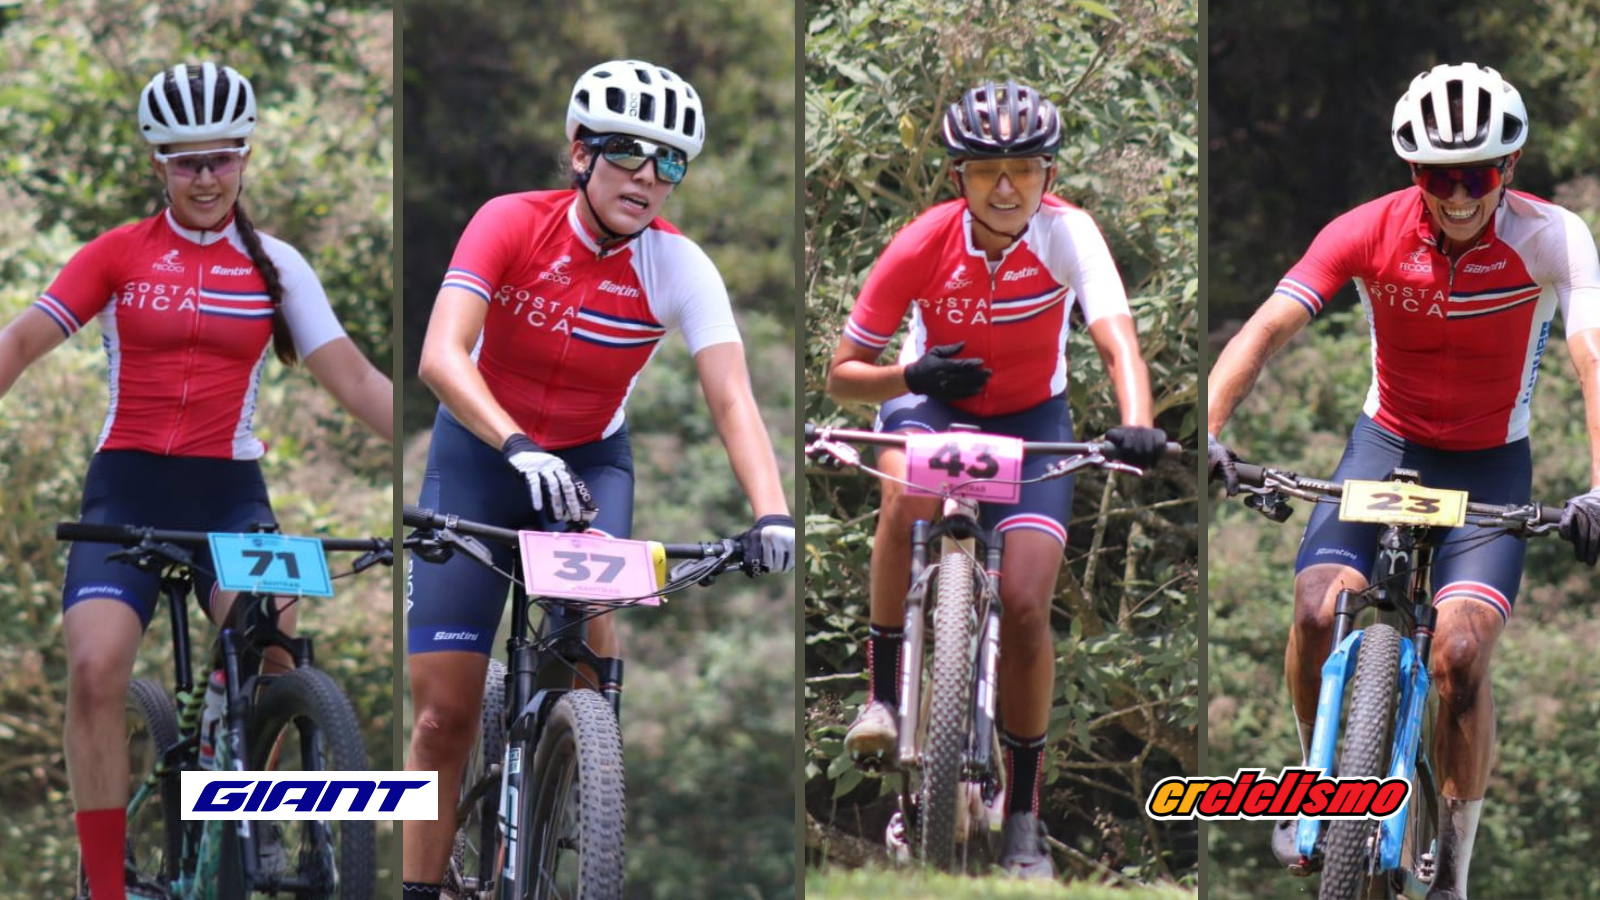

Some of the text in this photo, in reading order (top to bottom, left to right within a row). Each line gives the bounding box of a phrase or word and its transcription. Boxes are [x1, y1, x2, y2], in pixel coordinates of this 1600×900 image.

[121, 291, 197, 313] RICA
[124, 281, 197, 297] COSTA
[501, 284, 576, 319] COSTA
[927, 441, 999, 479] 43
[1366, 492, 1440, 514] 23
[241, 549, 301, 580] 71
[553, 550, 627, 584] 37
[433, 630, 480, 641] Santini
